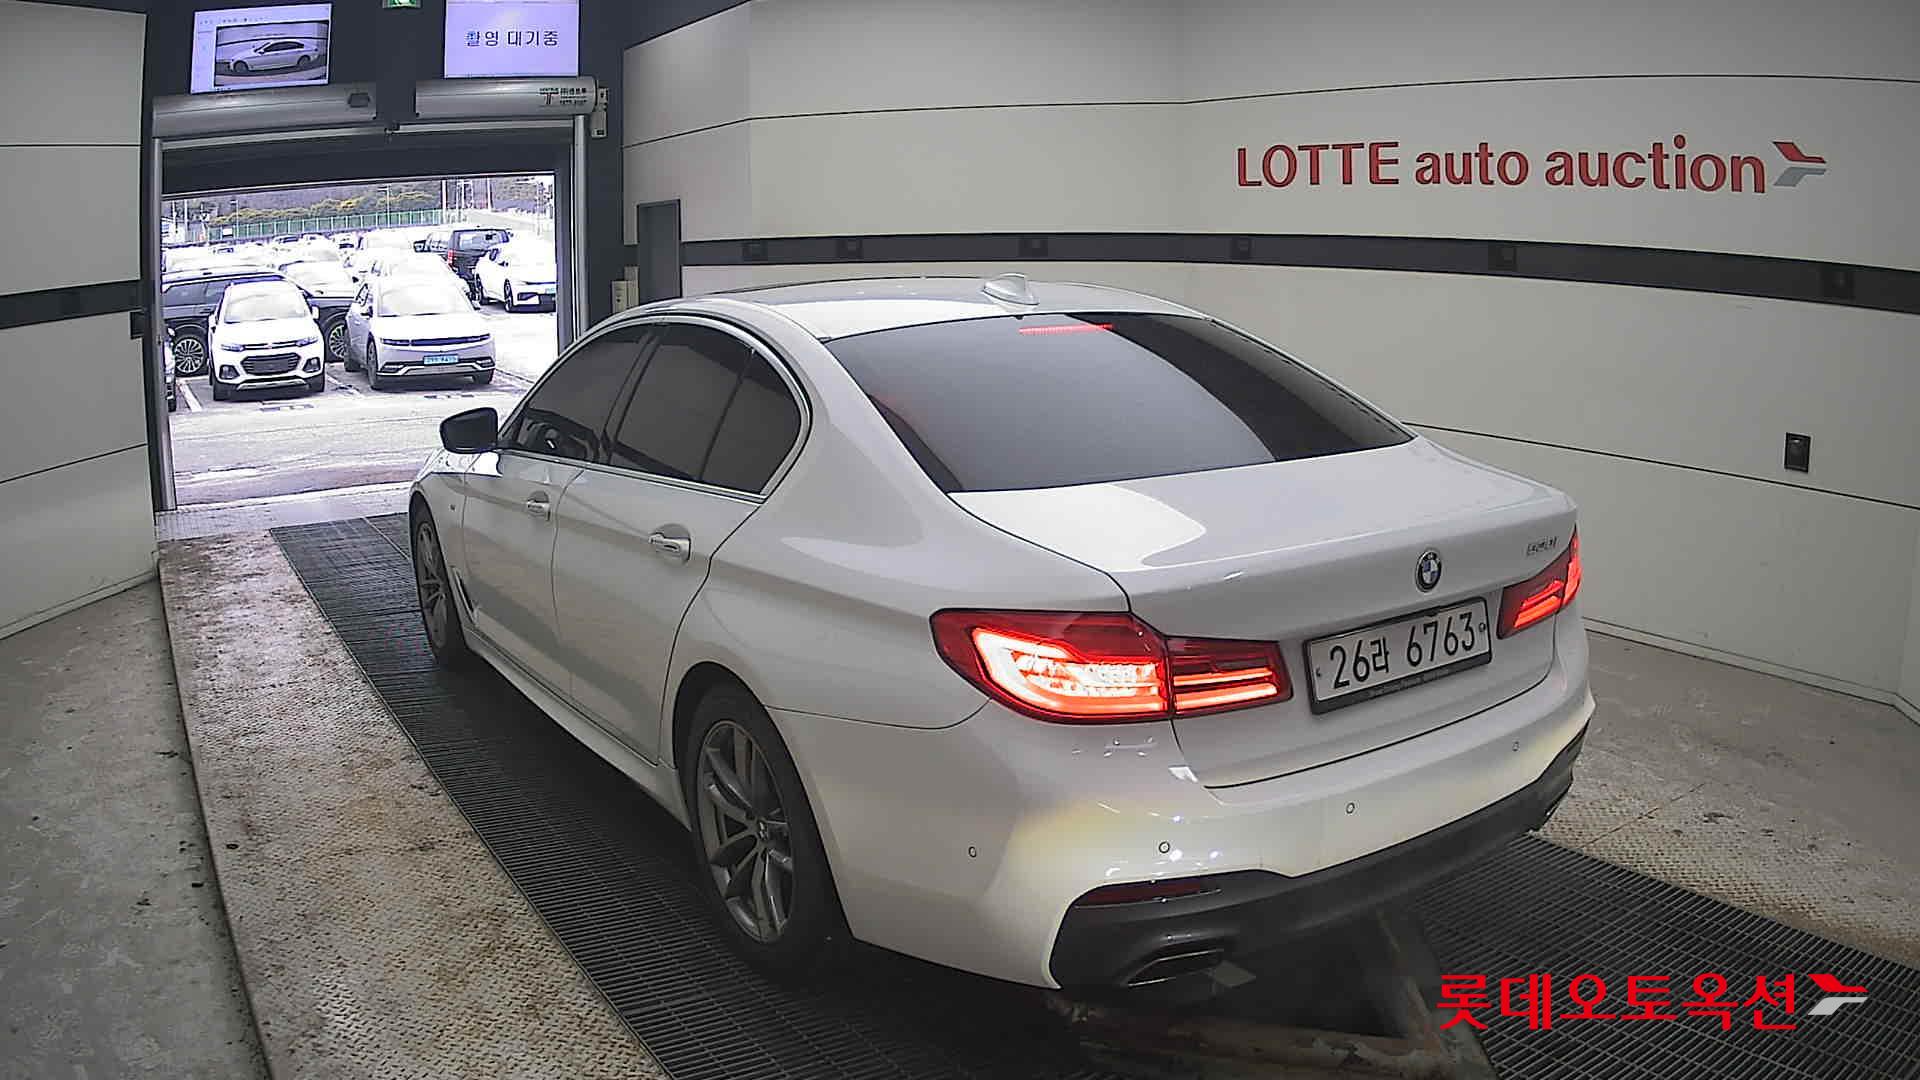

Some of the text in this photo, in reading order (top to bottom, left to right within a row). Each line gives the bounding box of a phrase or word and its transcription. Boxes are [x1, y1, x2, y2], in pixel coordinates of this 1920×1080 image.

[507, 31, 558, 46] 대기중
[1237, 134, 1767, 194] LOTTE auto auction
[1329, 636, 1390, 690] 26라
[1406, 611, 1476, 668] 6763
